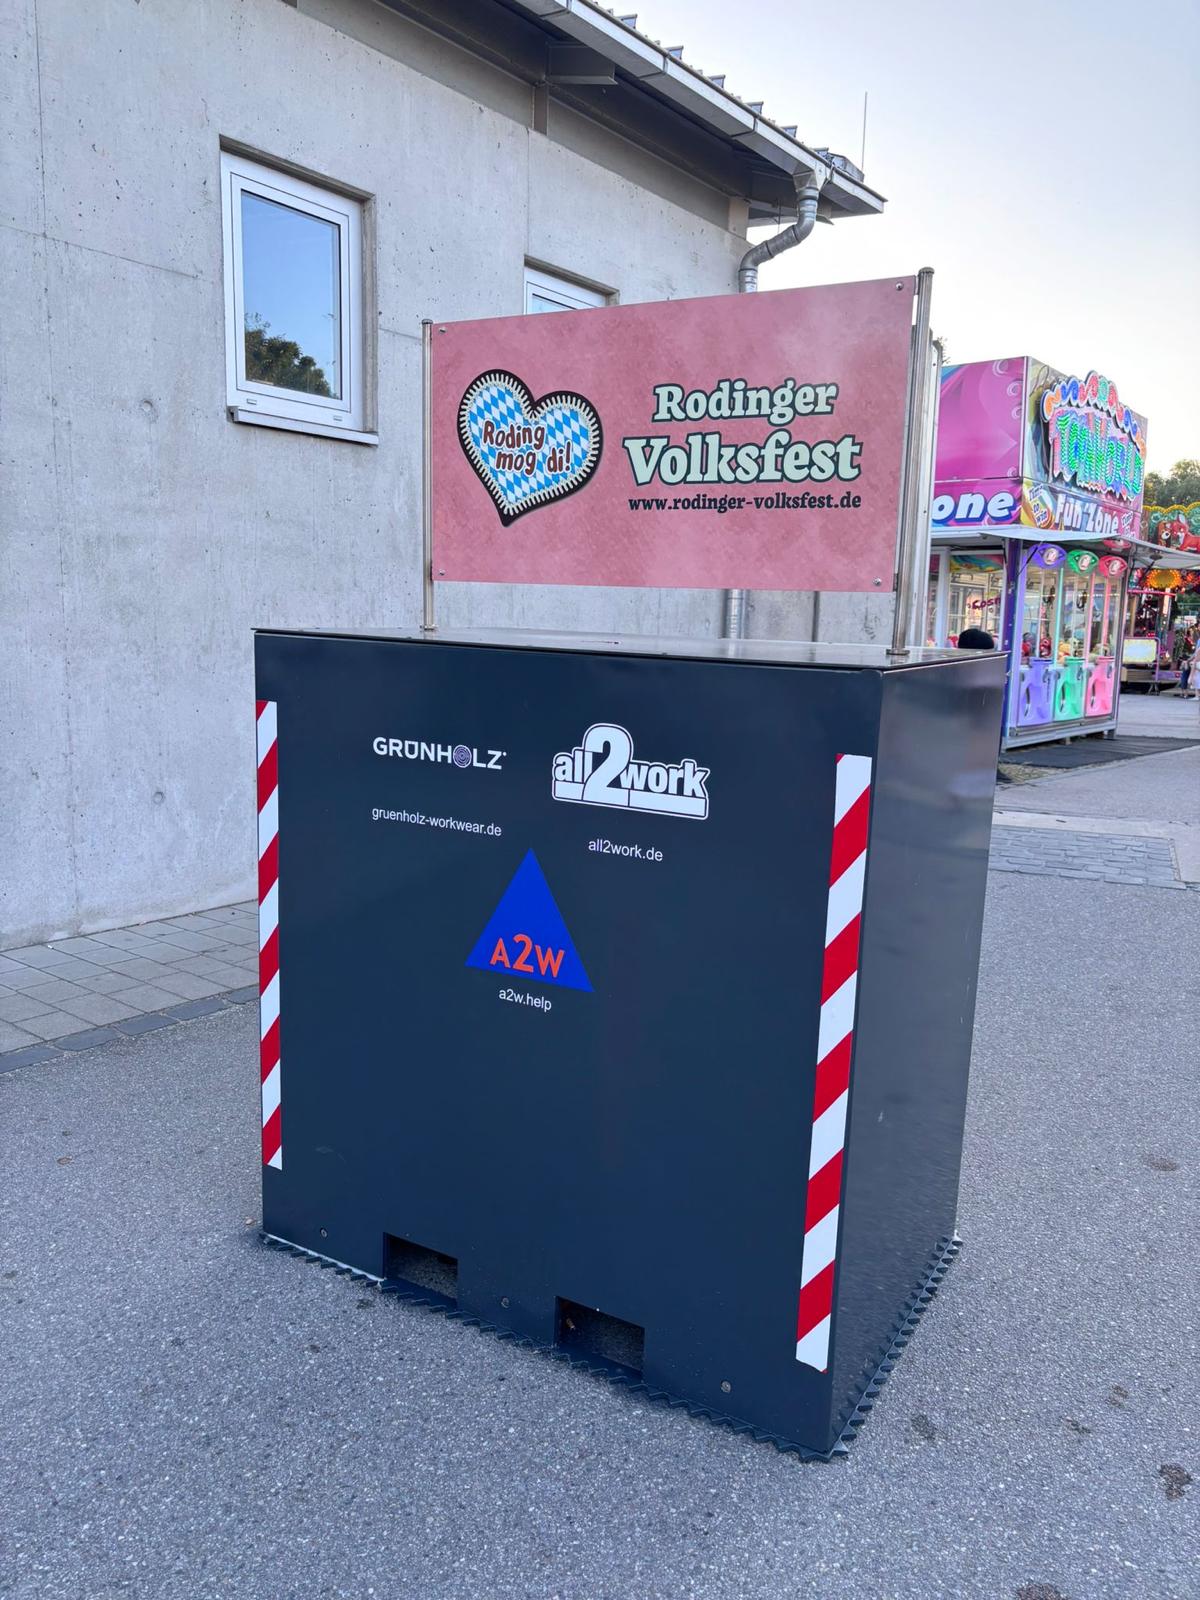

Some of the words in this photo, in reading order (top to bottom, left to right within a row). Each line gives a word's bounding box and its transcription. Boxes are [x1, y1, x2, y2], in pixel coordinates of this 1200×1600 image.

[652, 378, 840, 425] Rodinger
[482, 420, 546, 452] Roding
[495, 450, 537, 476] mog
[546, 442, 572, 473] di!
[623, 429, 863, 486] Volksfest
[628, 491, 862, 514] www.rodinger-volksfest.de
[932, 491, 1015, 522] one
[553, 723, 709, 806] all2work
[371, 807, 502, 837] gruenholz-workwear.de
[588, 838, 663, 863] all2work.de
[489, 933, 565, 978] A2W
[498, 988, 552, 1013] a2w.help
